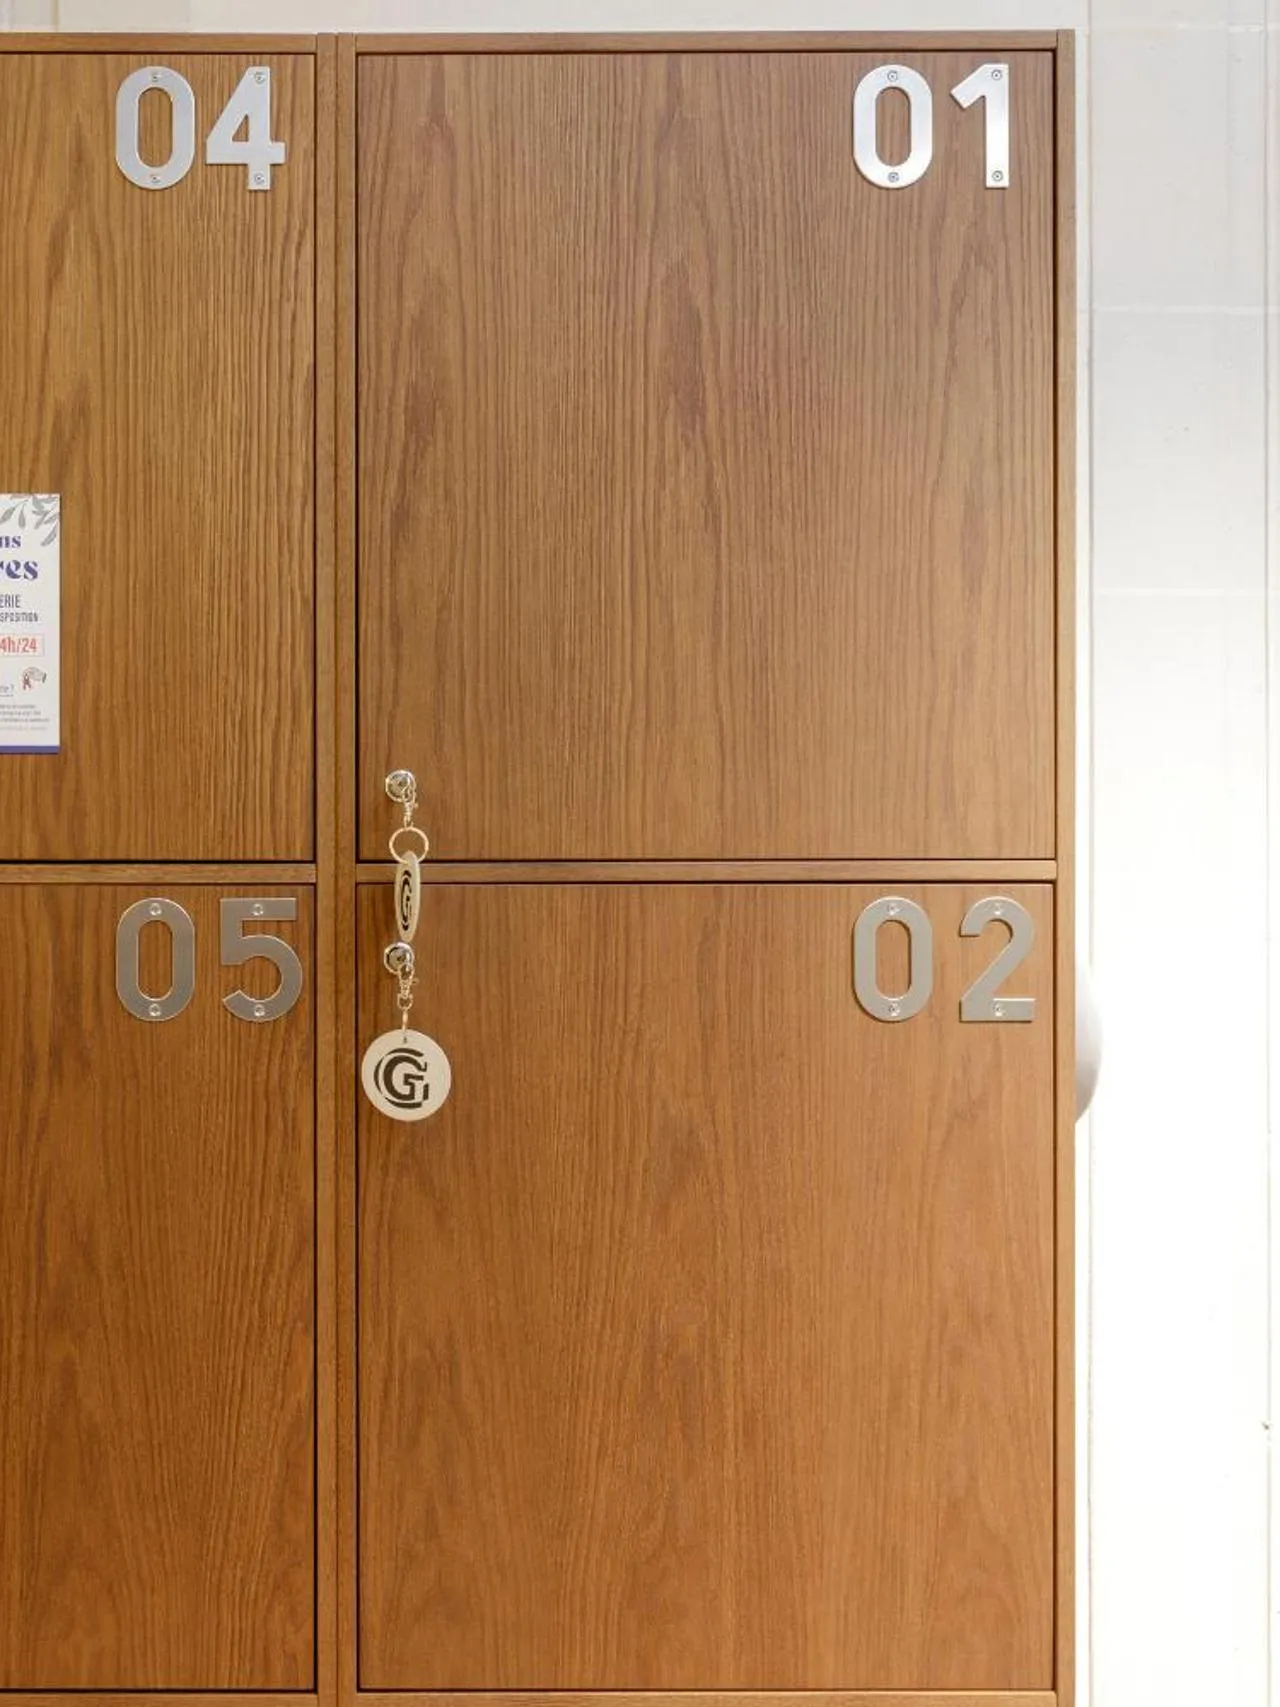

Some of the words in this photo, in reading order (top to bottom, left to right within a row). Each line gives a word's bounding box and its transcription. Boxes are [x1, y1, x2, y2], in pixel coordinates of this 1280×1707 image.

[116, 66, 286, 190] 04
[853, 63, 1010, 188] 01
[116, 898, 303, 1022] 05
[853, 896, 1036, 1022] 02
